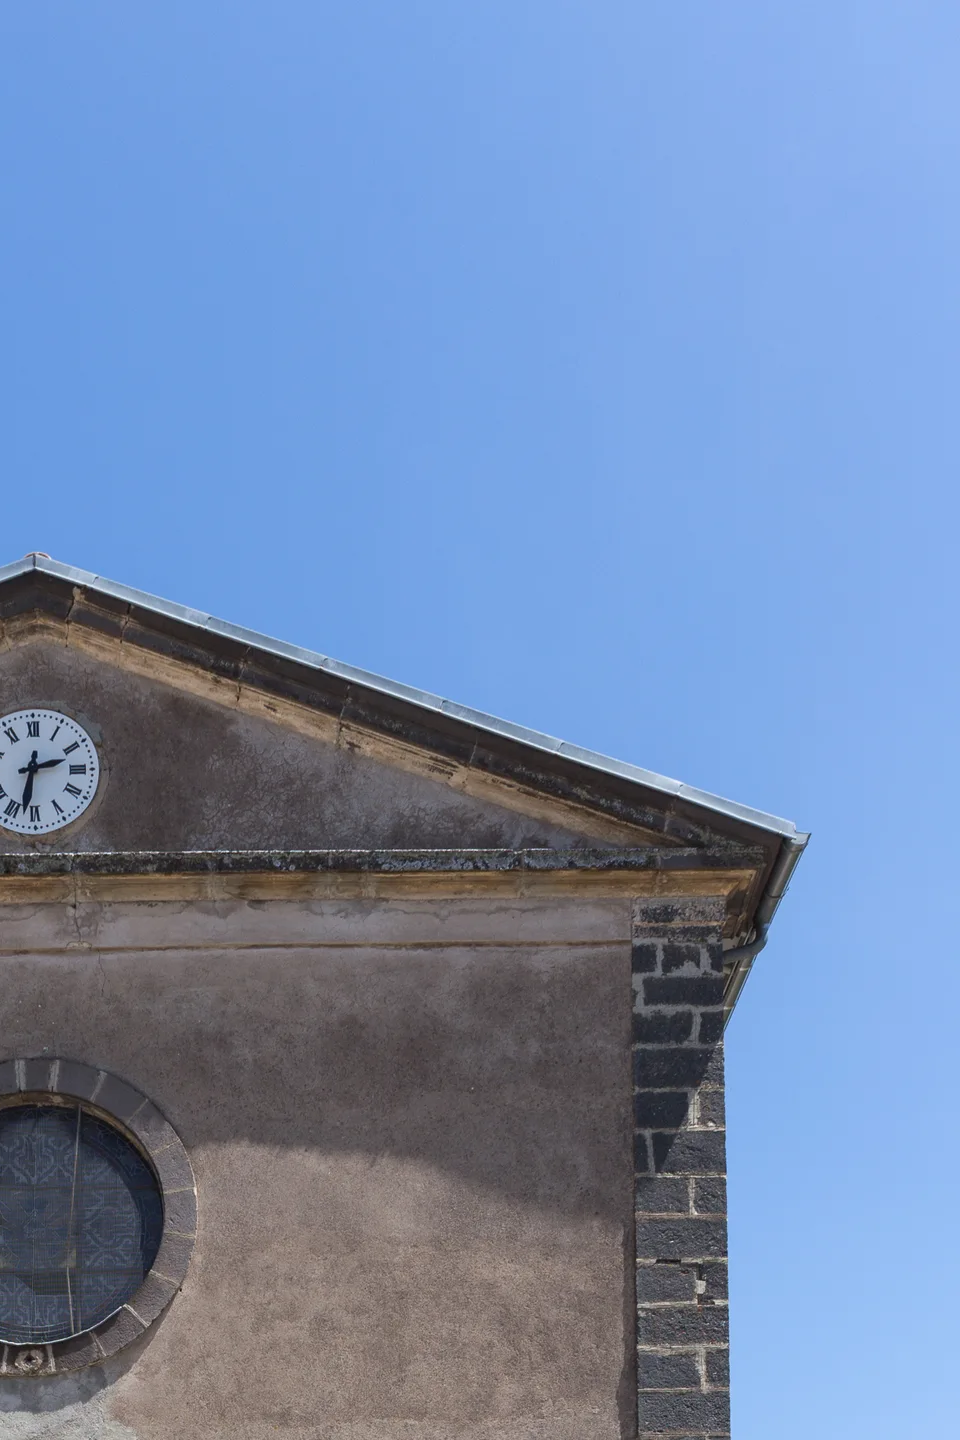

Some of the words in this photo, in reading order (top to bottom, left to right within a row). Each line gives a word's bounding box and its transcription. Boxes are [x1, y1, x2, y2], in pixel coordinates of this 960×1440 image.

[4, 727, 20, 744] XI
[27, 721, 40, 737] XII
[50, 726, 60, 741] I
[63, 741, 80, 755] II
[69, 764, 86, 775] III
[4, 799, 22, 818] VII
[30, 805, 40, 822] VI
[51, 799, 64, 815] V
